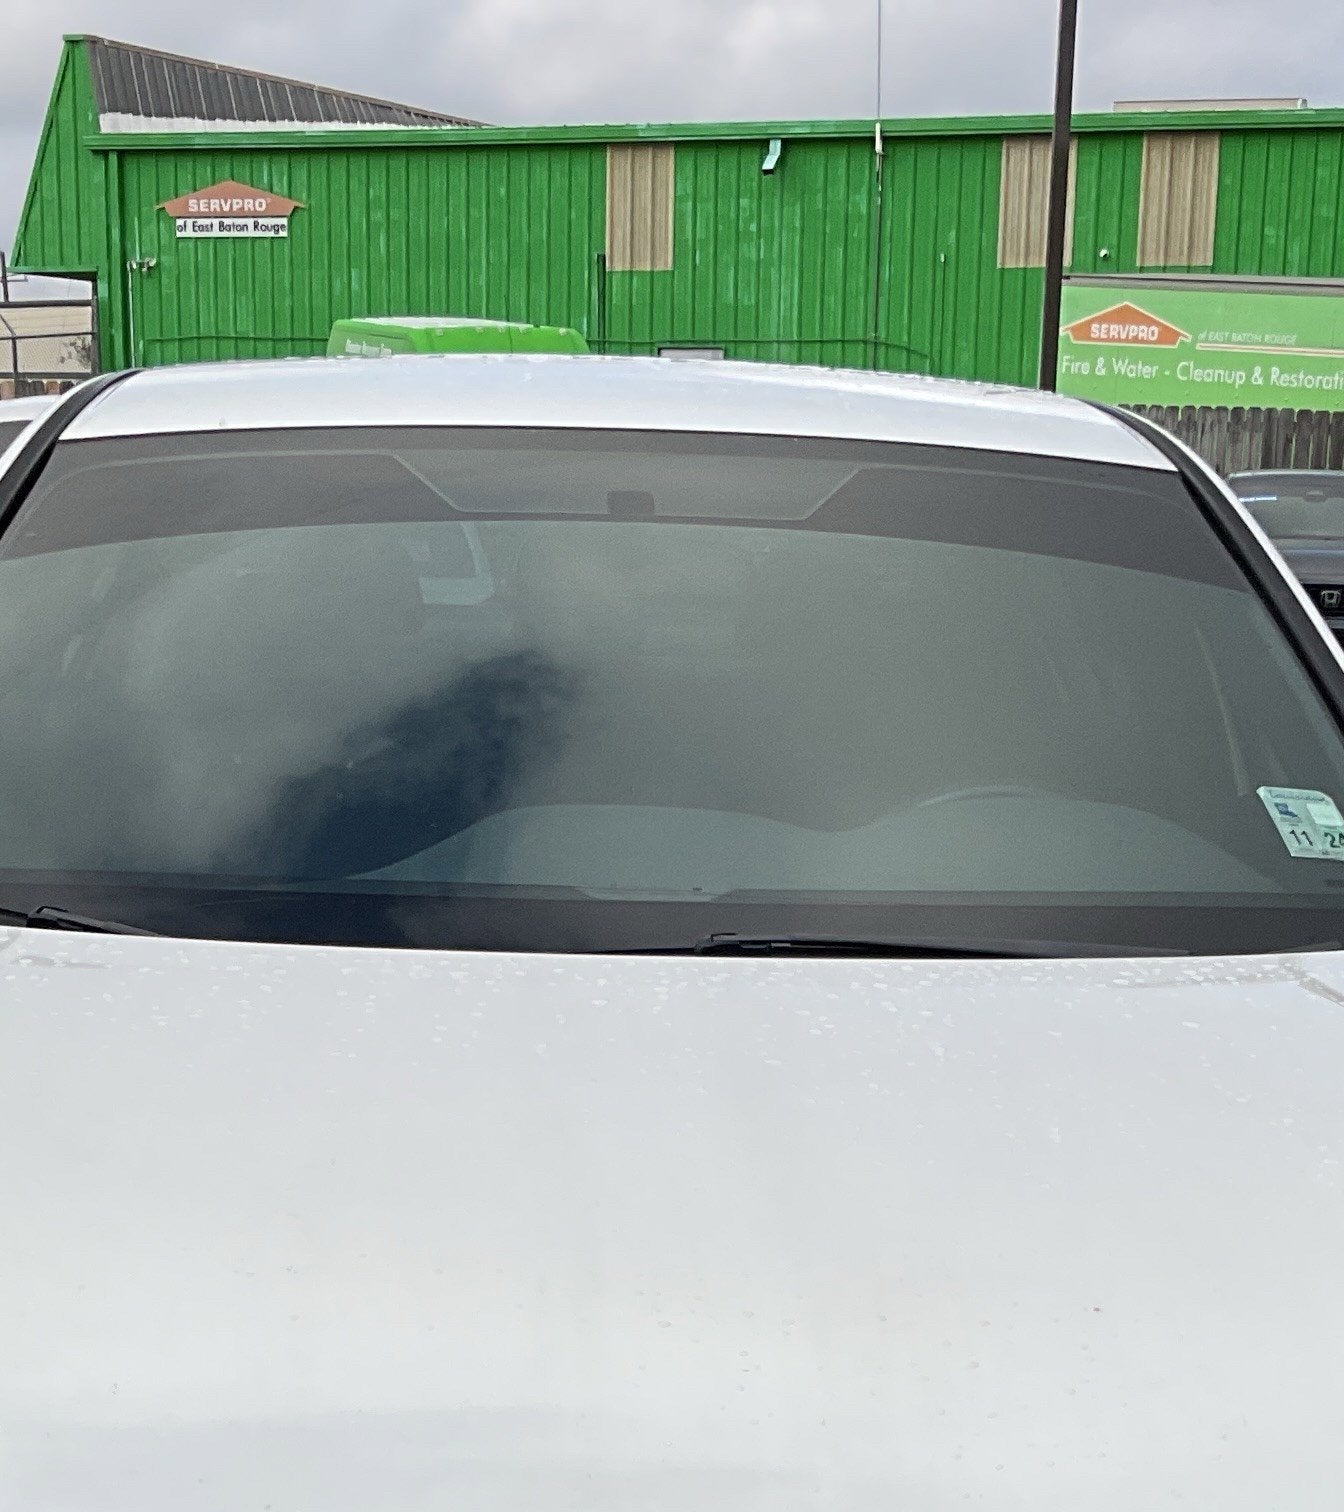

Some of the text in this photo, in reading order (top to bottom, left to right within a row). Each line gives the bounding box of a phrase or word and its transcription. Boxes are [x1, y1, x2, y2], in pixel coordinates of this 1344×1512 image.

[188, 199, 267, 212] SERVPRO
[176, 221, 287, 235] of East Baton Rouge
[1090, 323, 1159, 342] SERVPRO
[1208, 331, 1229, 342] EAST
[1062, 355, 1091, 374] Fire
[1095, 357, 1106, 375] &
[1112, 357, 1159, 379] Water
[1176, 360, 1246, 389] Cleanup
[1251, 366, 1264, 385] &
[1289, 829, 1313, 847] 11
